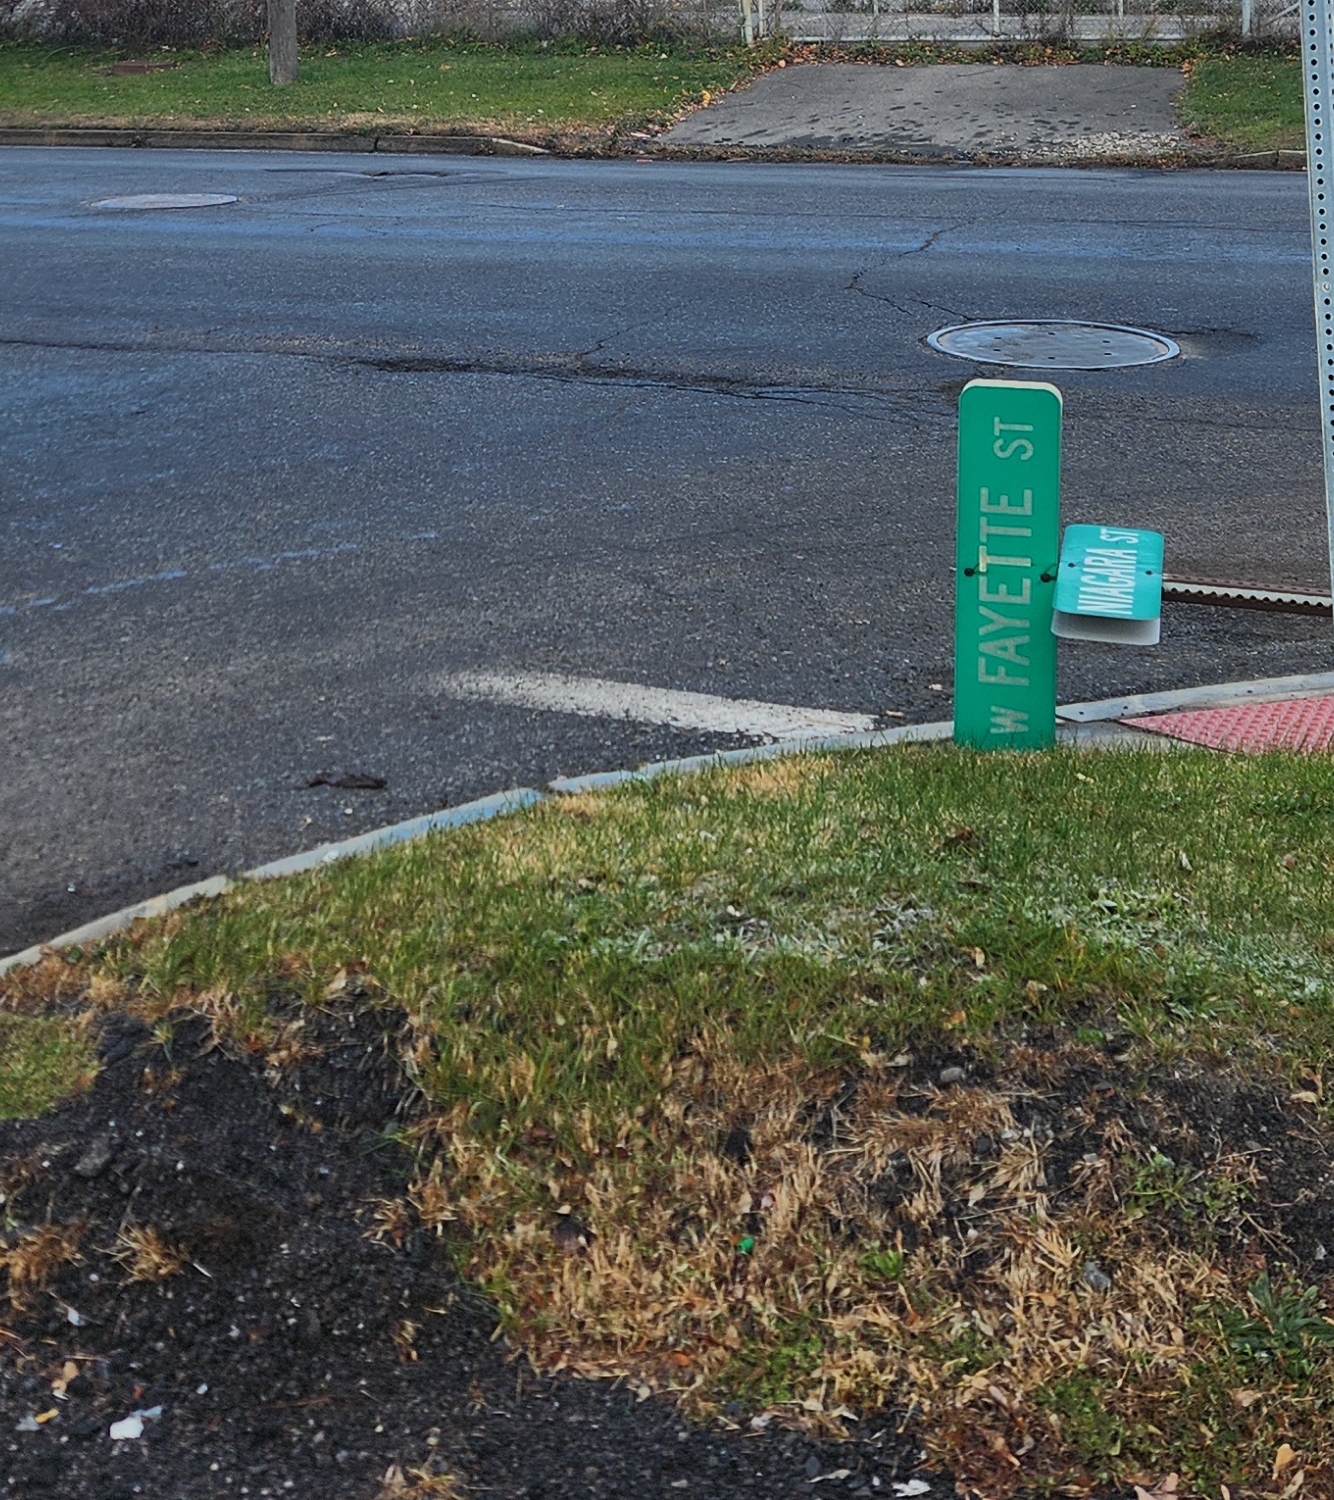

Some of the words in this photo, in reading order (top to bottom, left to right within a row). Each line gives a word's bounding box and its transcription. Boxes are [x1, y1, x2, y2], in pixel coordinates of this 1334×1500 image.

[993, 416, 1034, 460] ST
[1100, 527, 1140, 544] ST
[978, 487, 1033, 686] FAYETTE
[1077, 547, 1137, 616] NIAGARA
[990, 706, 1030, 735] W
